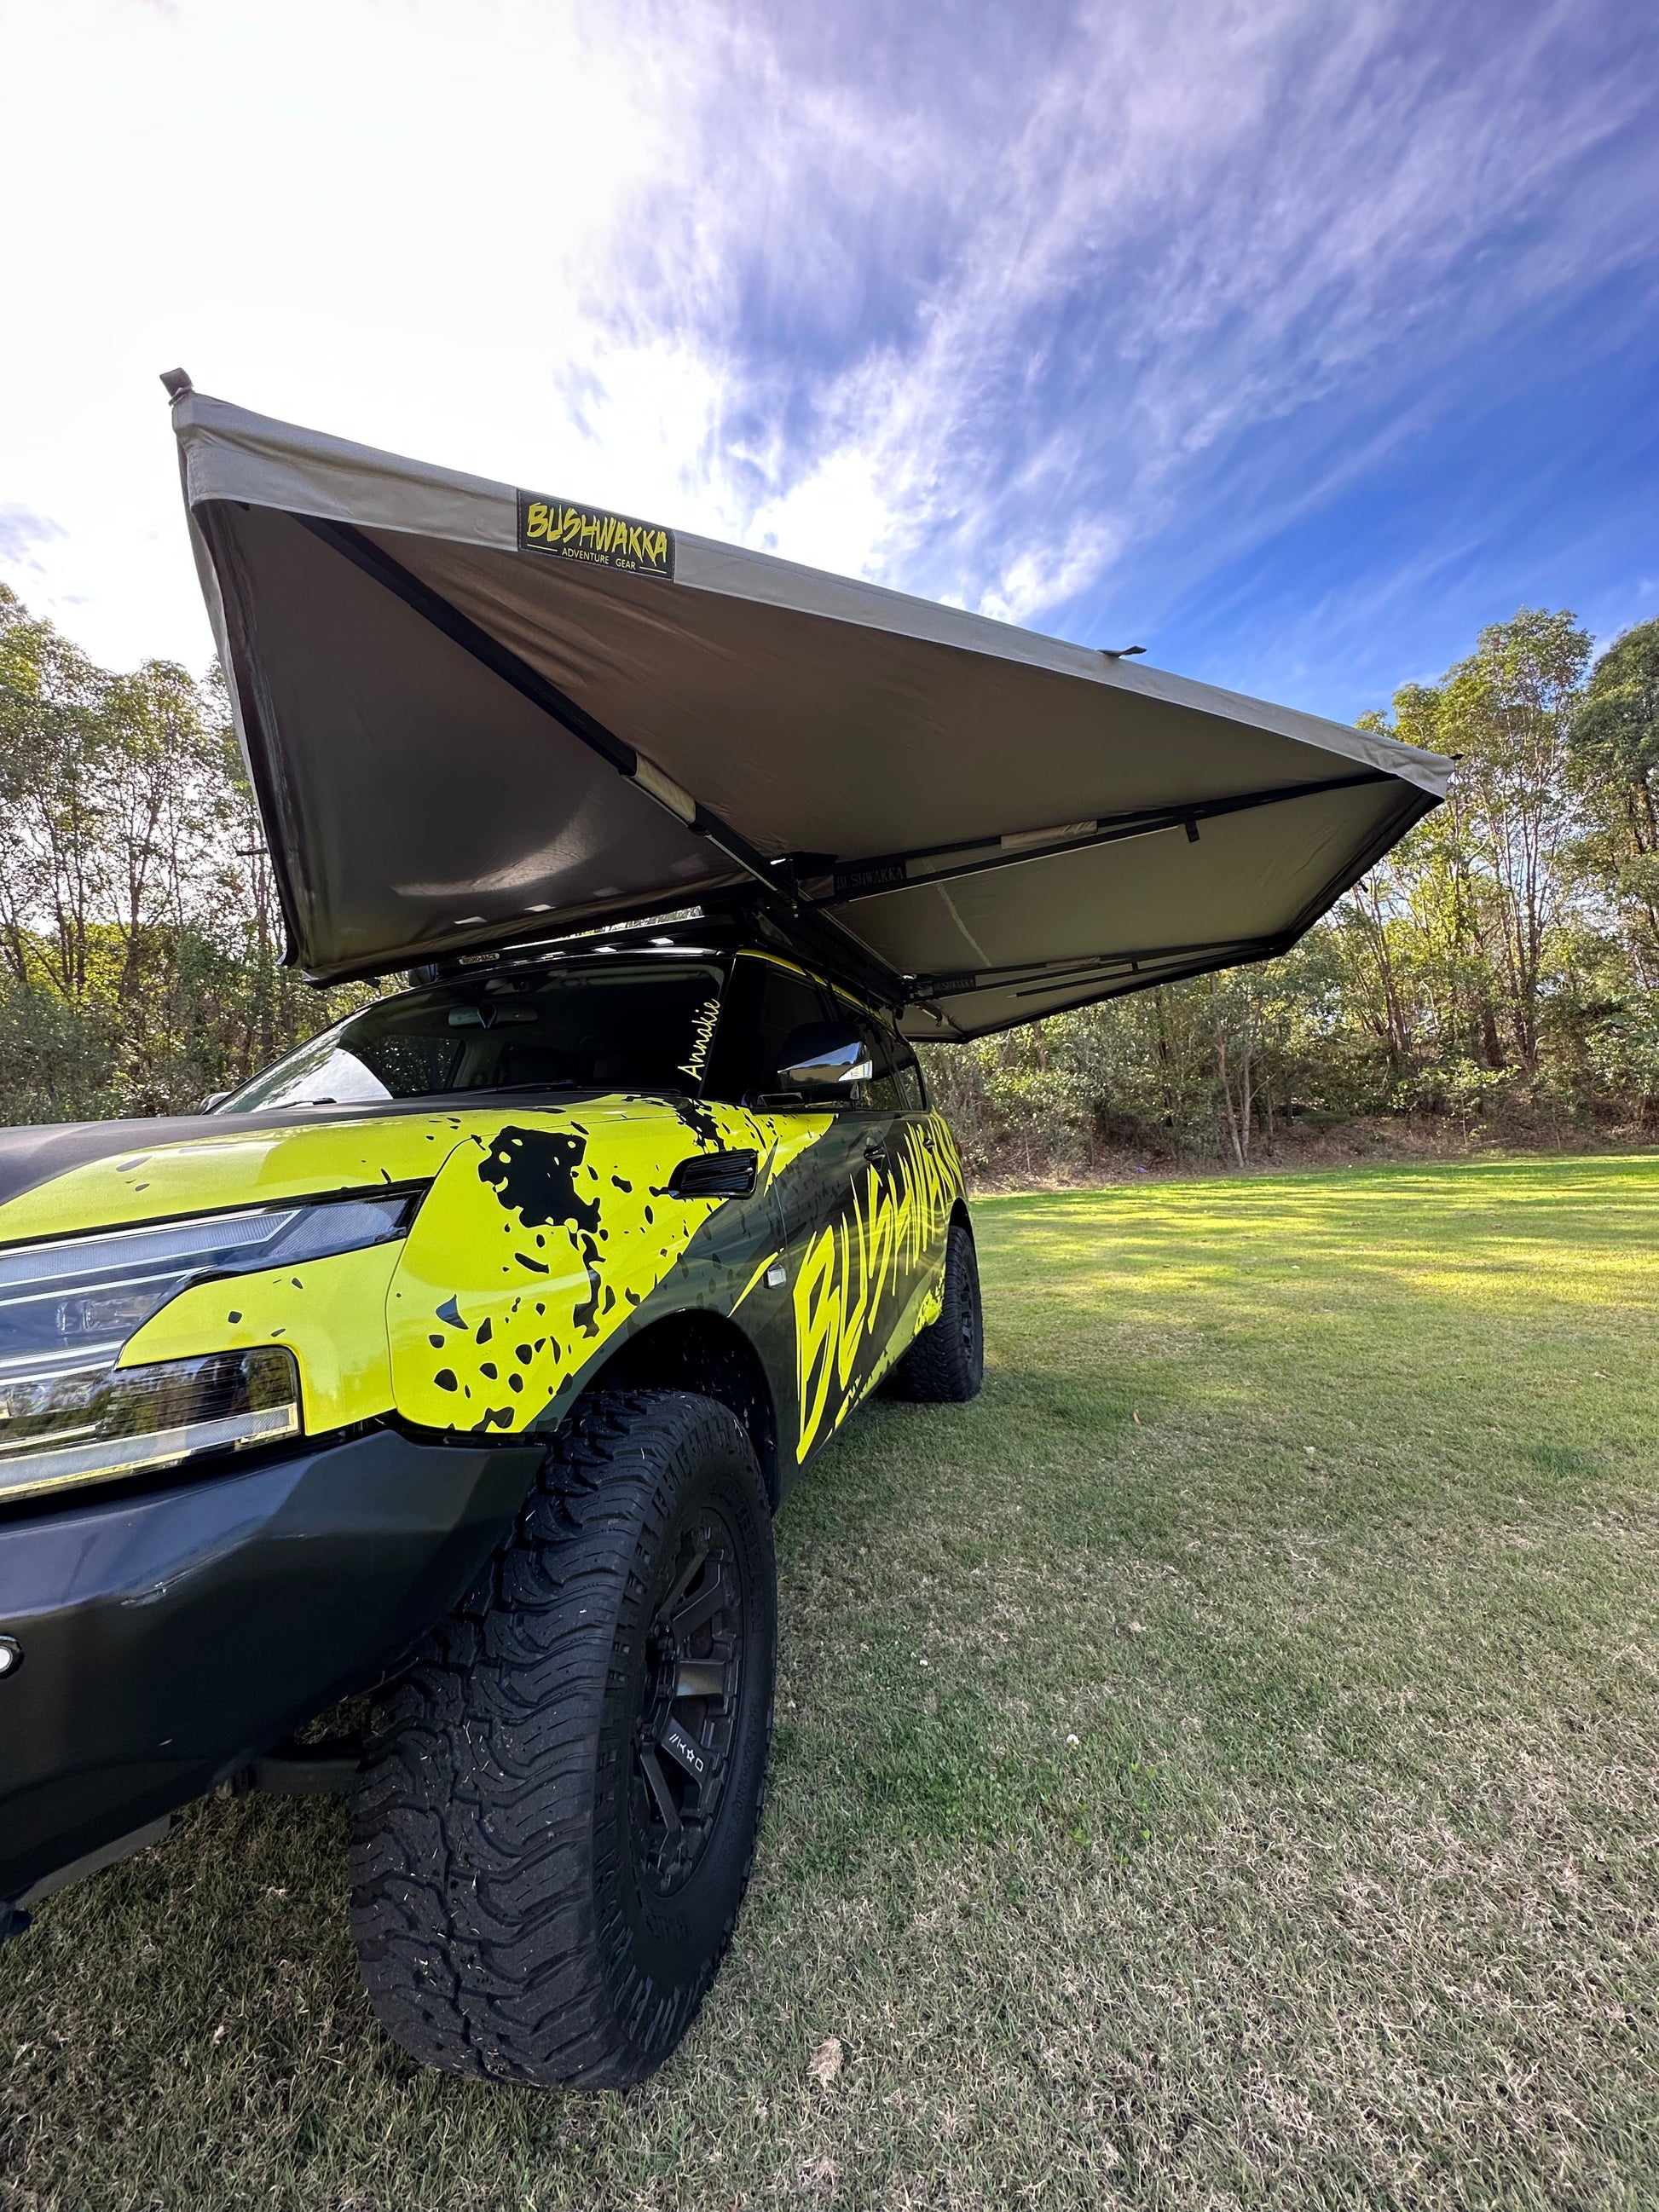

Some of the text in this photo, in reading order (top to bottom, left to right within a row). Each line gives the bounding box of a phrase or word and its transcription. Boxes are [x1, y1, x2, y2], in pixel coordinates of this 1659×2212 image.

[527, 502, 668, 567] BUSHWAKKA
[561, 547, 636, 570] ADVENTURE GEAR
[835, 866, 905, 889] BUSHWAKKA
[677, 998, 721, 1082] Annakie
